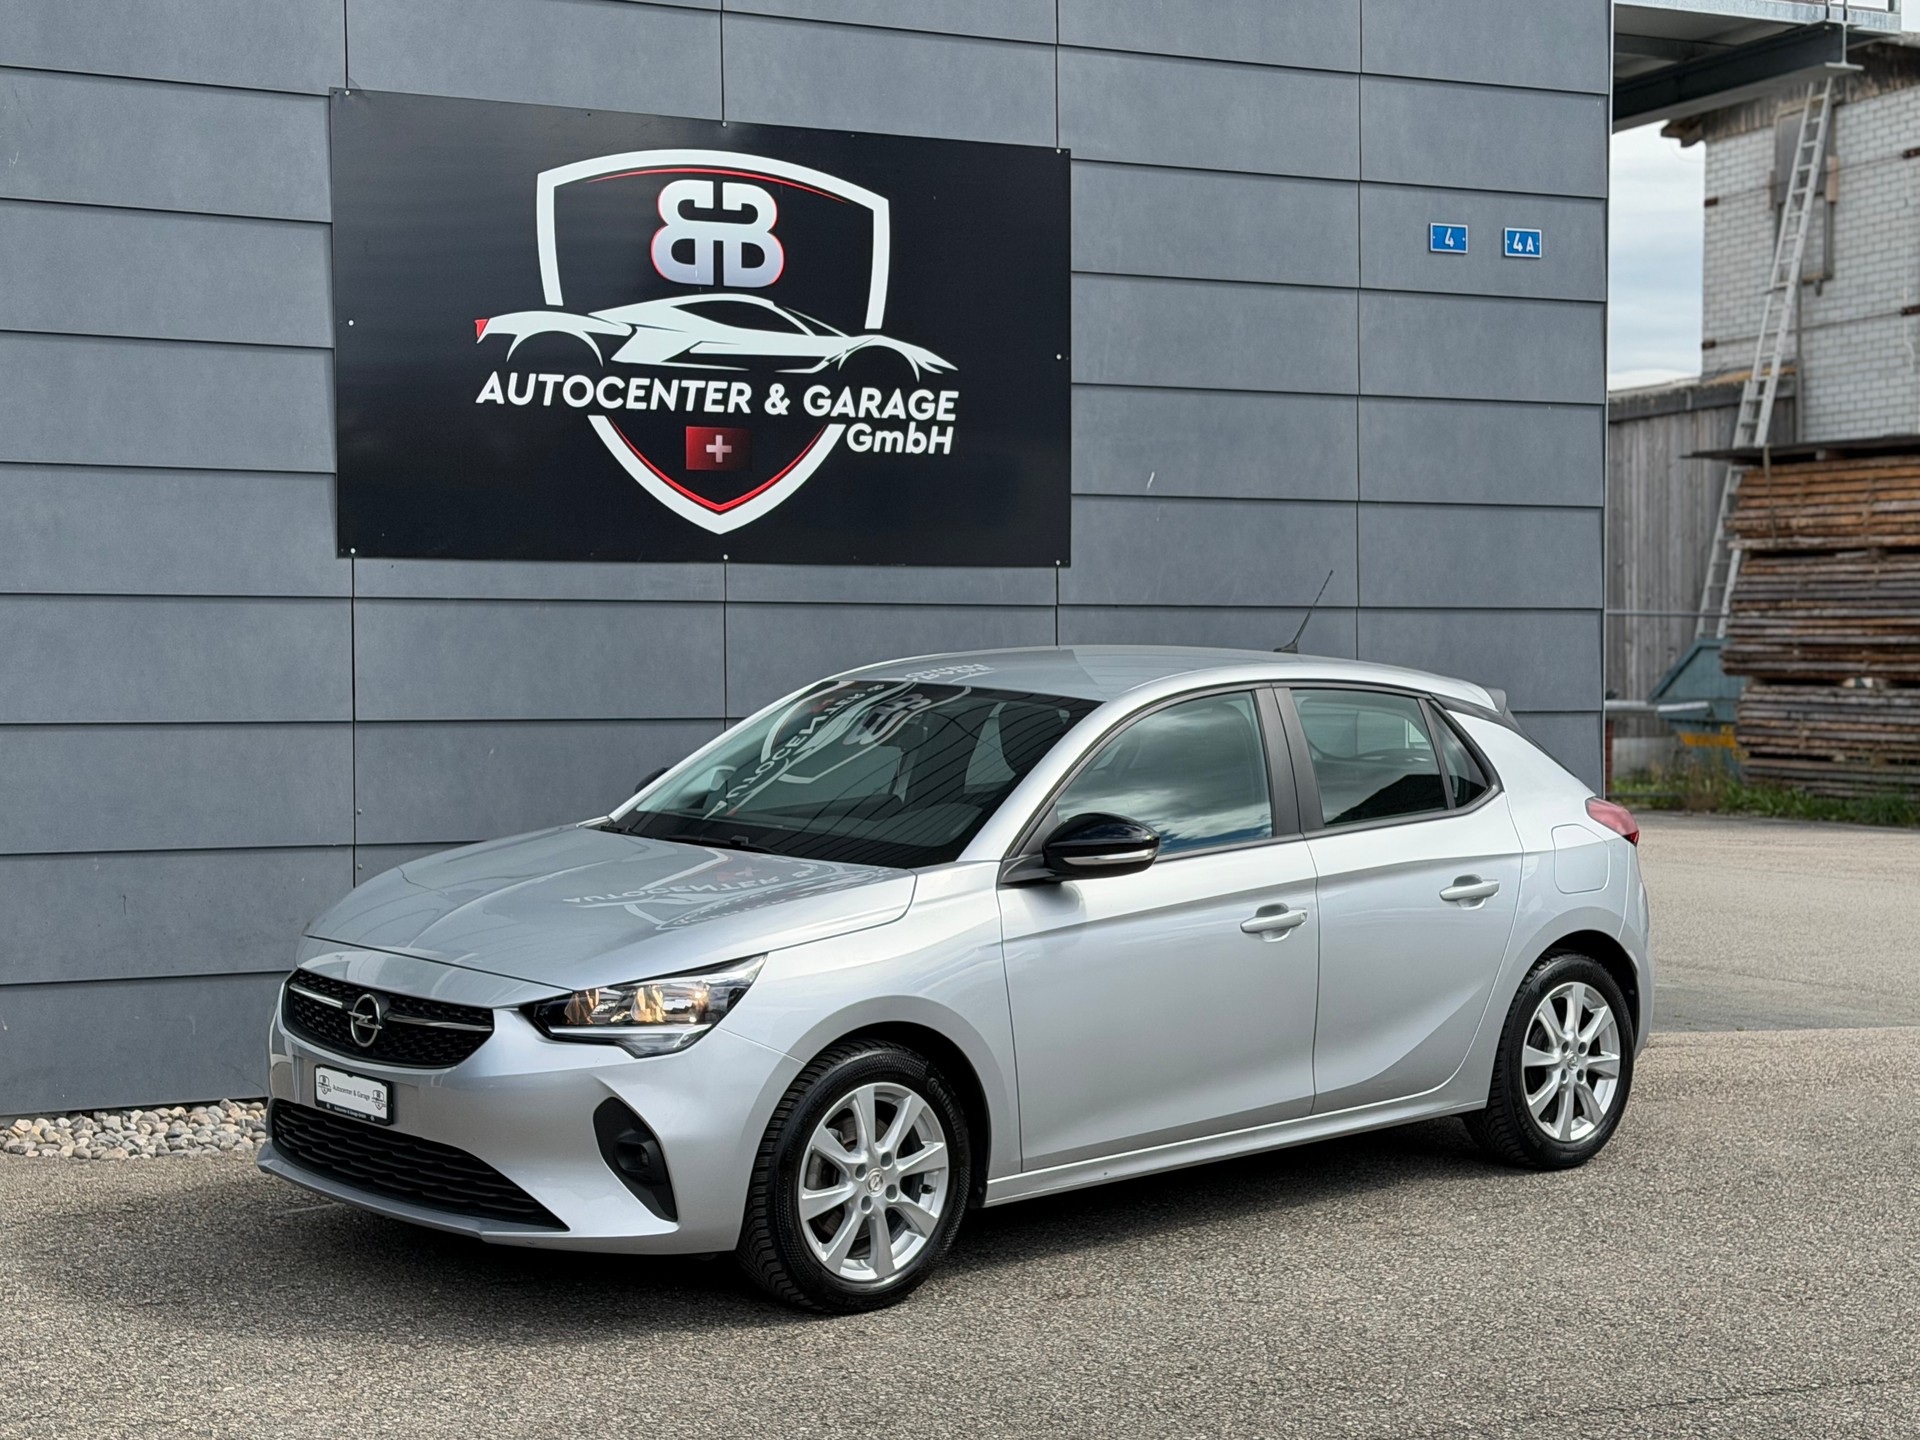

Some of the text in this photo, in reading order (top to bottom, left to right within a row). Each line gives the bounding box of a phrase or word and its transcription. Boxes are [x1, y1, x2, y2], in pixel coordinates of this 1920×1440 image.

[1445, 228, 1455, 248] 4
[1512, 232, 1535, 253] 4A
[475, 370, 960, 422] AUTOCENTER & GARAGE
[846, 422, 954, 455] GmbH
